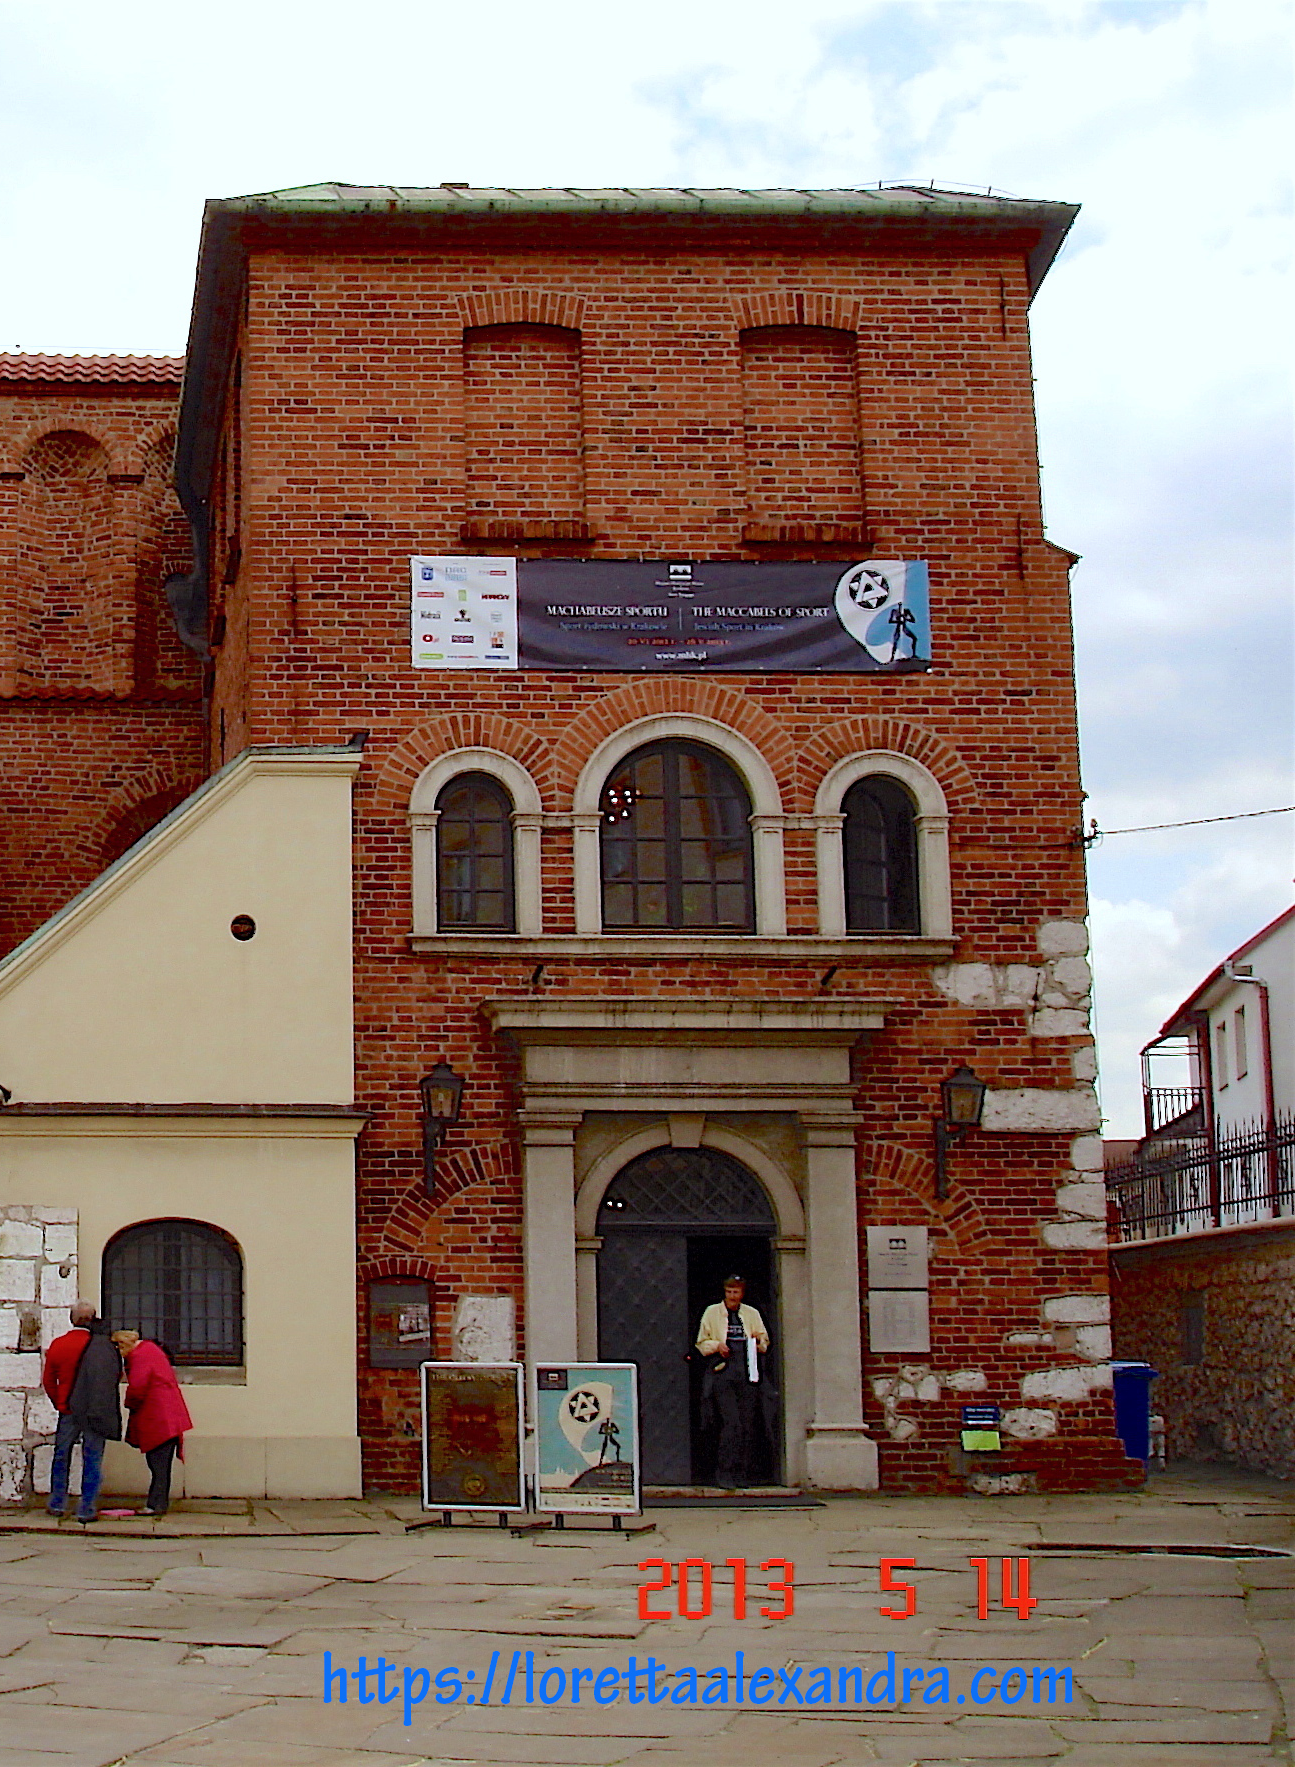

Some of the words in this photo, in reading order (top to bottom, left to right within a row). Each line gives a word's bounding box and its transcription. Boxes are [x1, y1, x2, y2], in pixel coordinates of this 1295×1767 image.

[625, 606, 668, 617] SPORTU
[692, 606, 713, 616] THE
[778, 607, 791, 617] OF
[795, 607, 830, 617] SPORT
